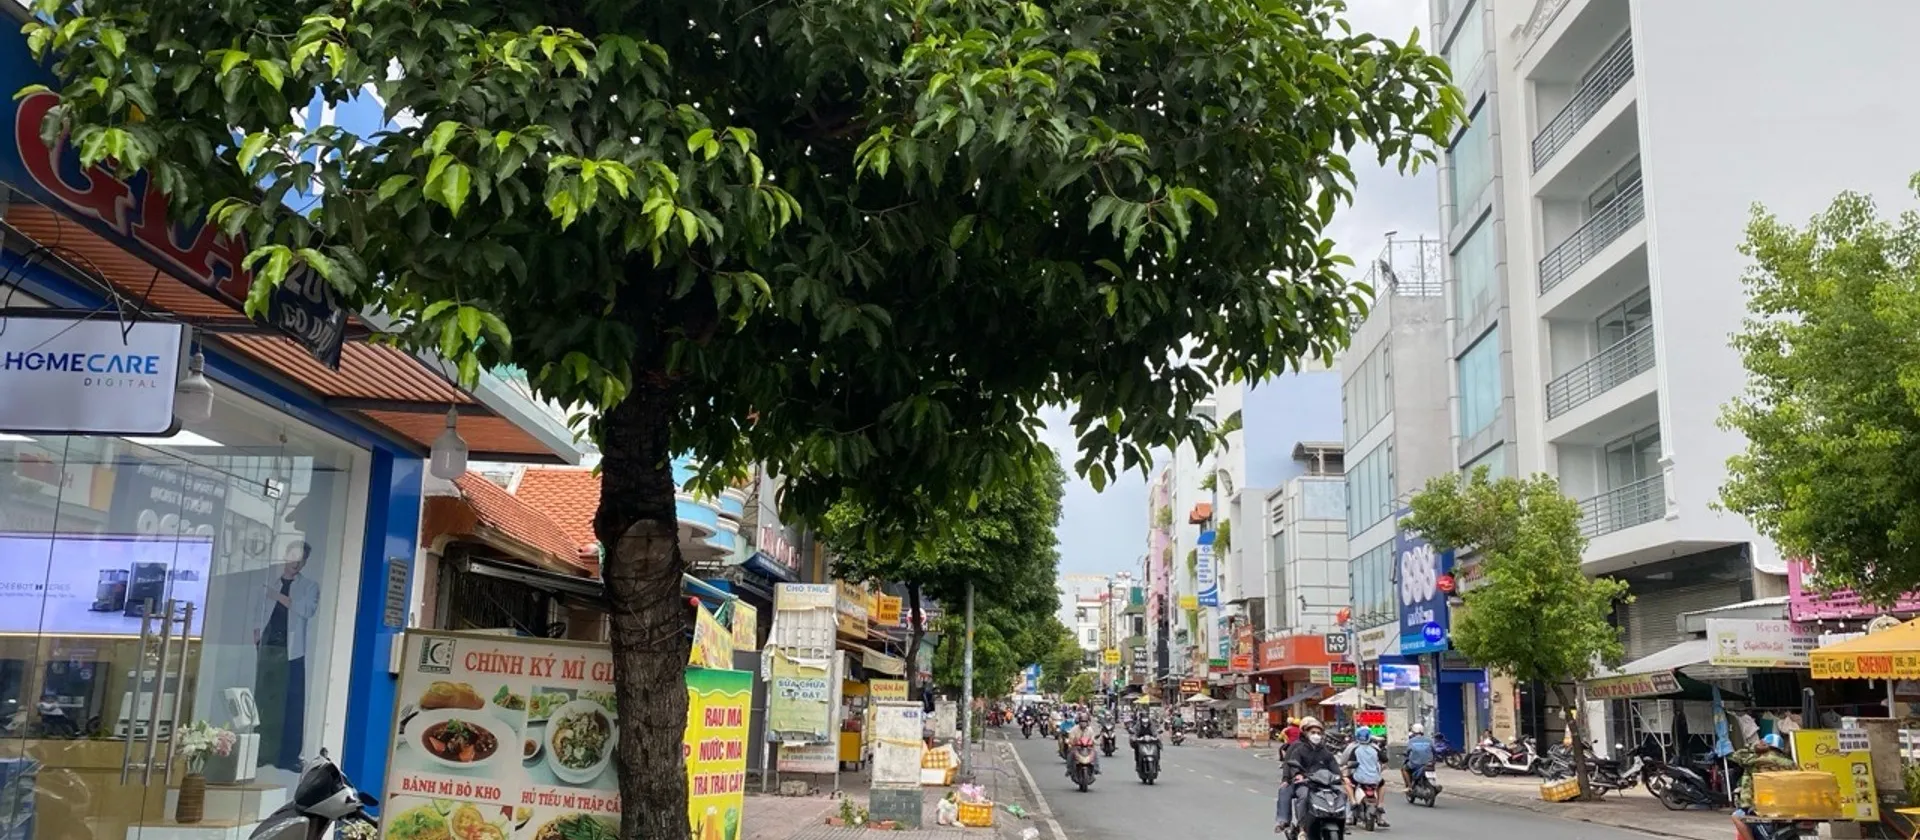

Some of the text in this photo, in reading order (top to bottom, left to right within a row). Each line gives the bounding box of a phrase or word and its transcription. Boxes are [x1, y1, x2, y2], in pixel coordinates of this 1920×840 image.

[5, 352, 160, 374] HOMECARE
[84, 377, 157, 388] DIGITAL
[786, 584, 805, 592] CHO
[1329, 635, 1345, 643] TO
[464, 648, 525, 675] CHÍNH
[529, 653, 557, 678] KÝ
[561, 656, 586, 680] MÌ
[704, 705, 743, 727] RAU MÁ
[699, 737, 742, 761] NƯỚC MÍA
[402, 776, 501, 800] BÁNH MÌ BÒ KHO
[538, 788, 561, 806] TIẾU
[563, 792, 575, 808] MÌ
[577, 794, 604, 813] THẬP
